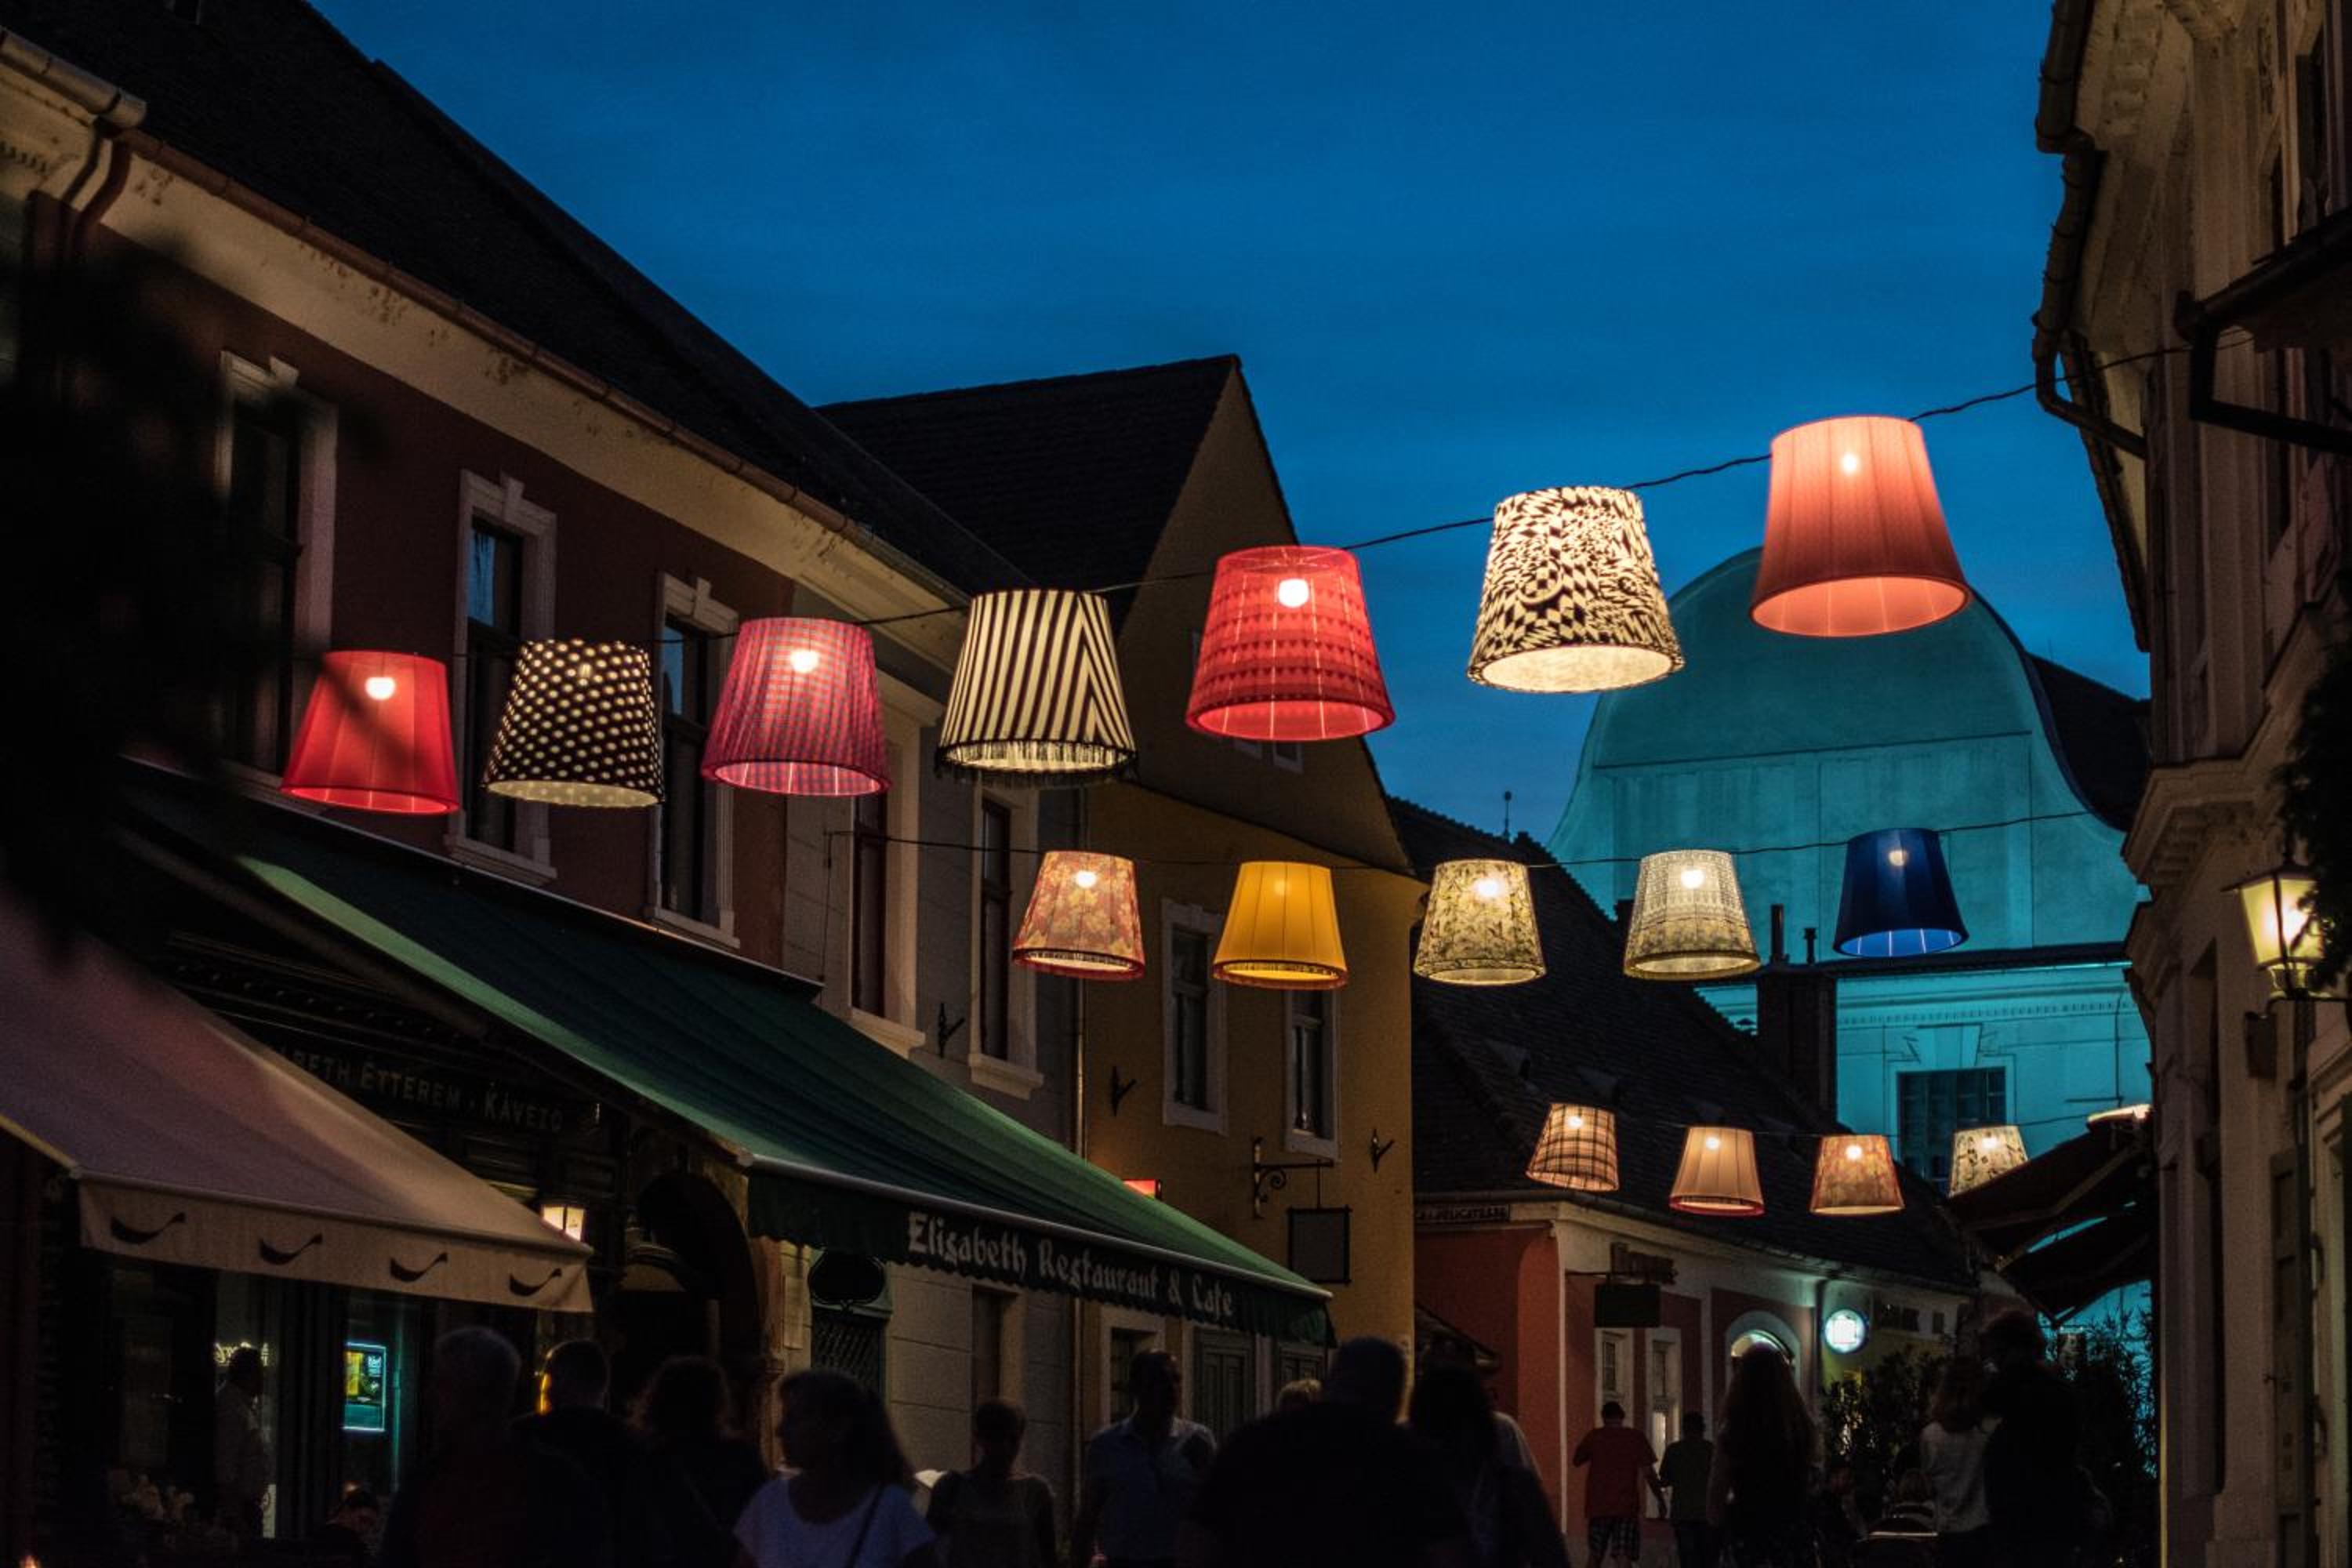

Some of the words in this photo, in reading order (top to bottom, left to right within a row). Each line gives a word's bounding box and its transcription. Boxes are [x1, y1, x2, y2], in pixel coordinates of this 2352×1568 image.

[908, 1210, 1029, 1281] Elisabeth
[1037, 1237, 1156, 1301] Restaurant
[1167, 1267, 1181, 1306] &
